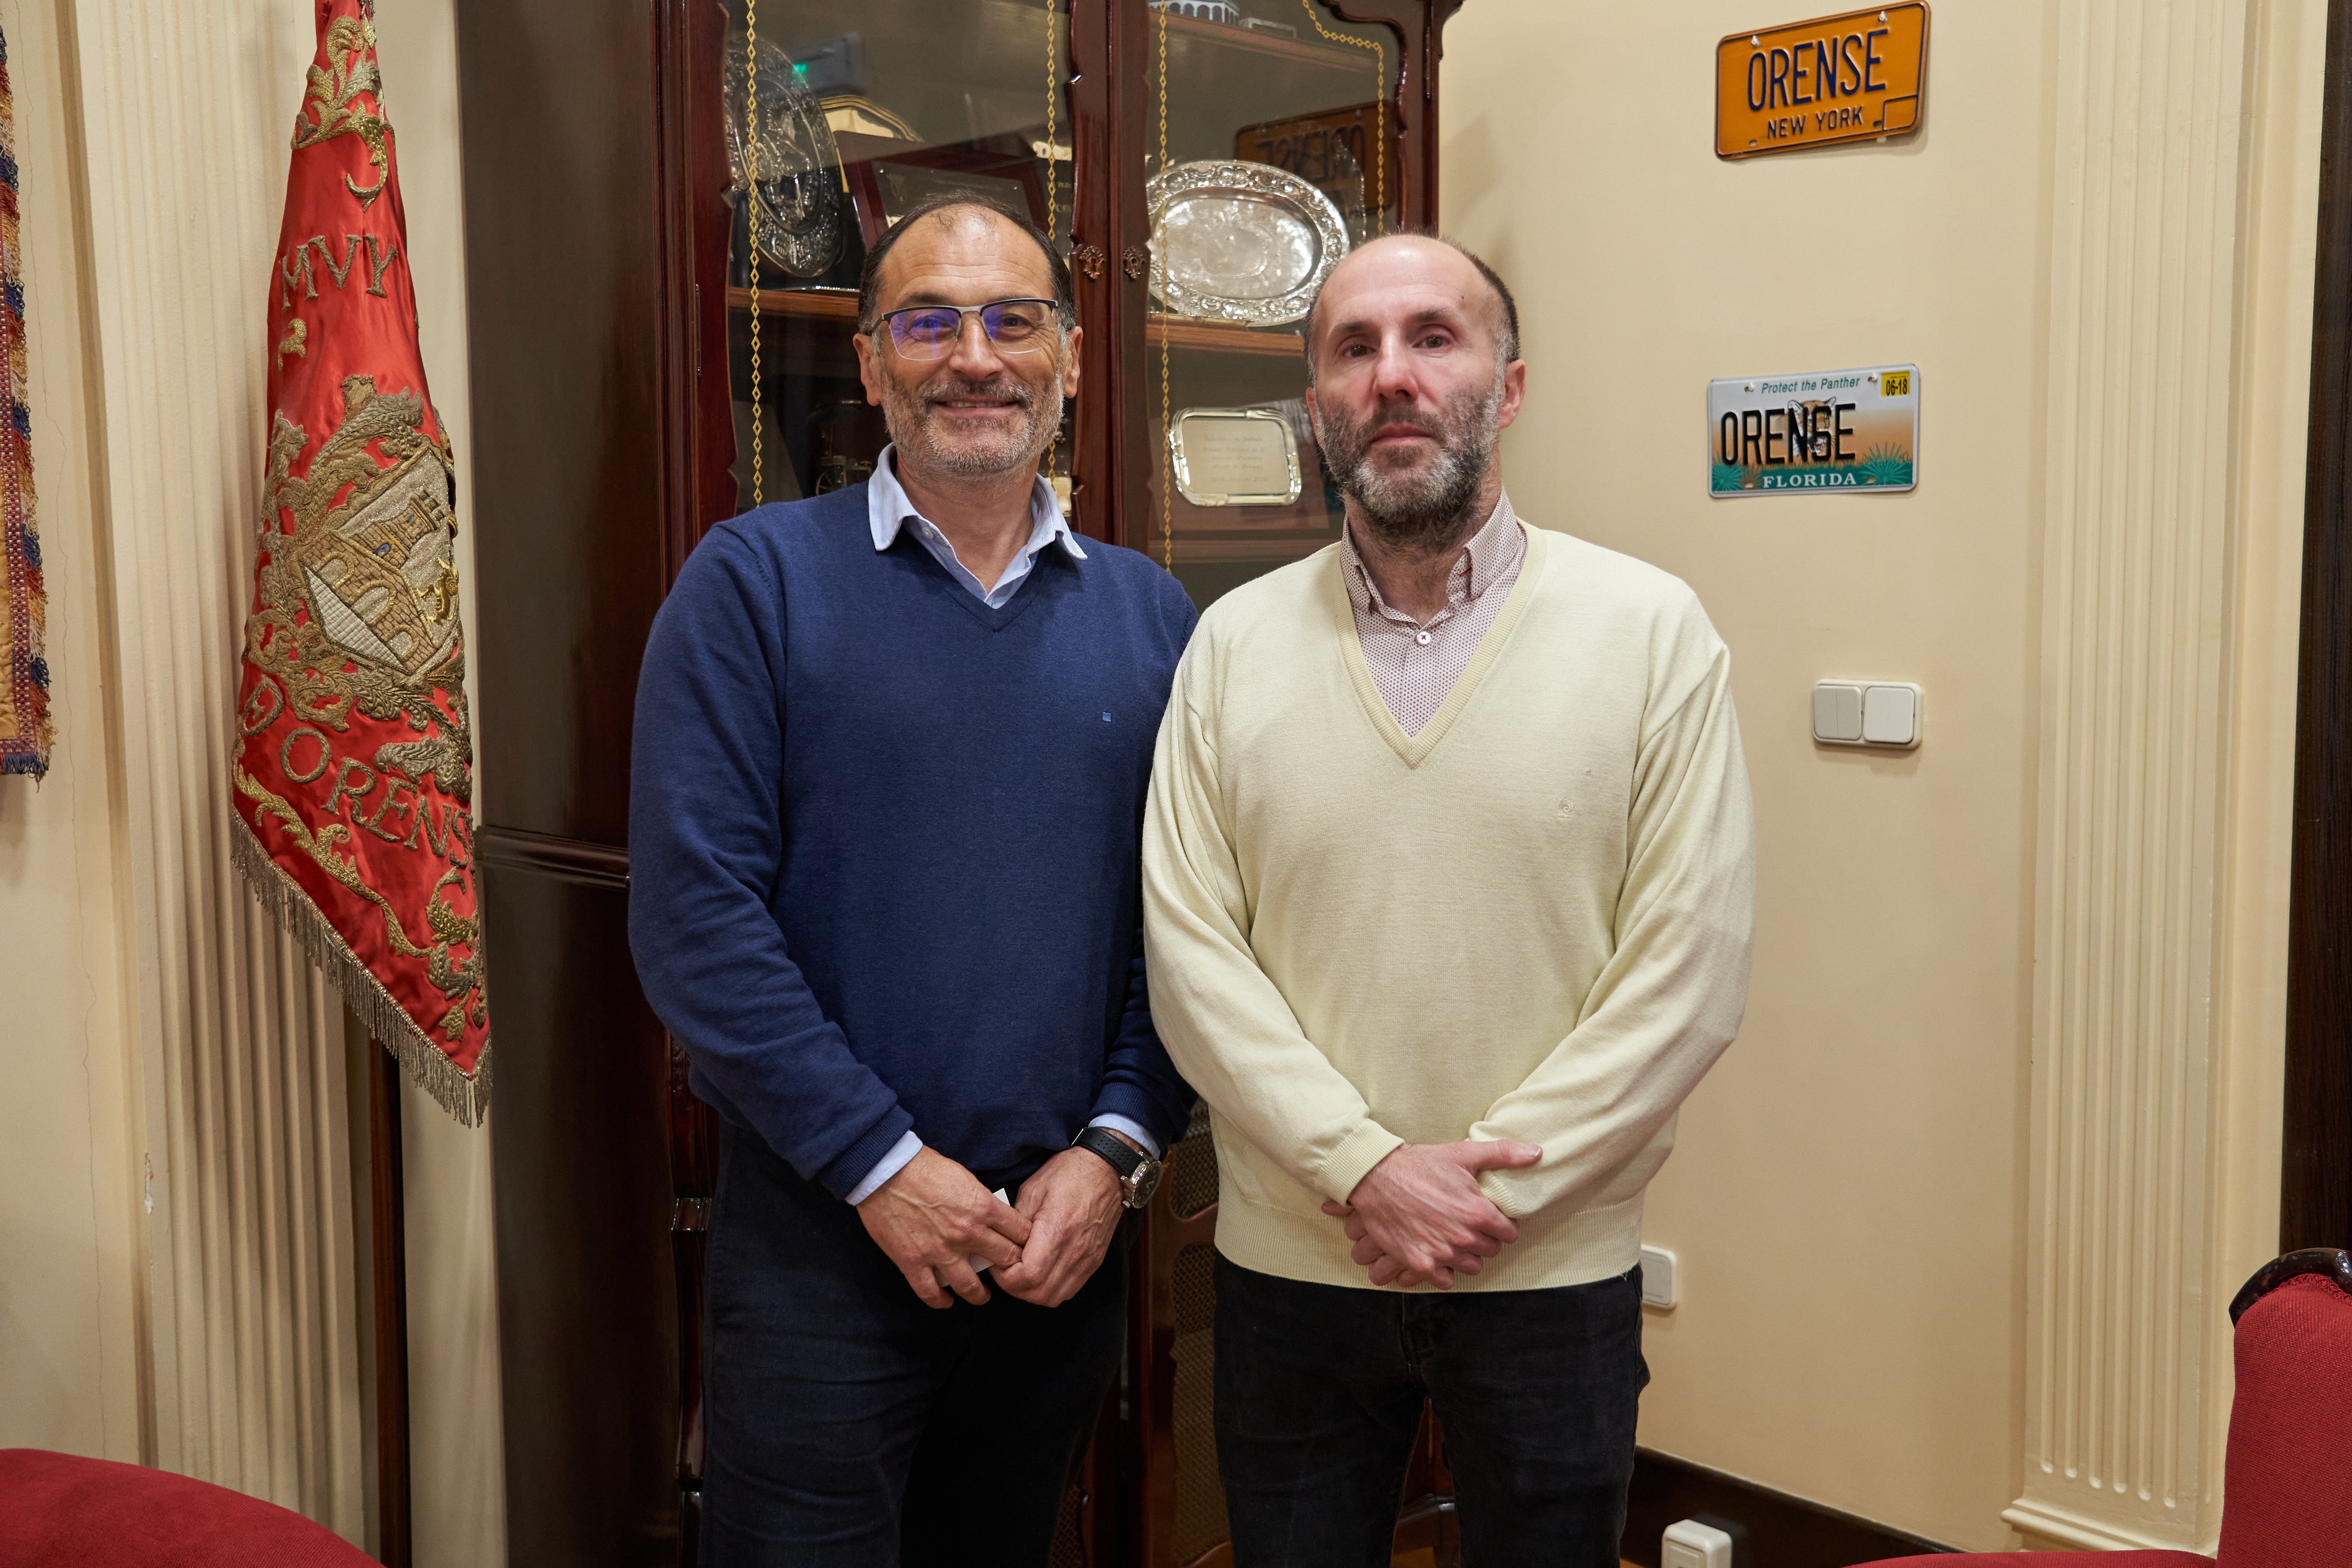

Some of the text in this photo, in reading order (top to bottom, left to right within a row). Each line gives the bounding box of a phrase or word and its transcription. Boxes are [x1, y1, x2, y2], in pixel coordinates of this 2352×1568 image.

[1748, 28, 1889, 111] ORENSE
[1767, 106, 1864, 139] NEW YORK
[1761, 377, 1860, 394] Protect the Panther
[1886, 378, 1907, 396] 06-18
[1720, 403, 1856, 466] ORENSE
[1763, 473, 1857, 488] FLORIDA
[280, 727, 475, 873] ORENS
